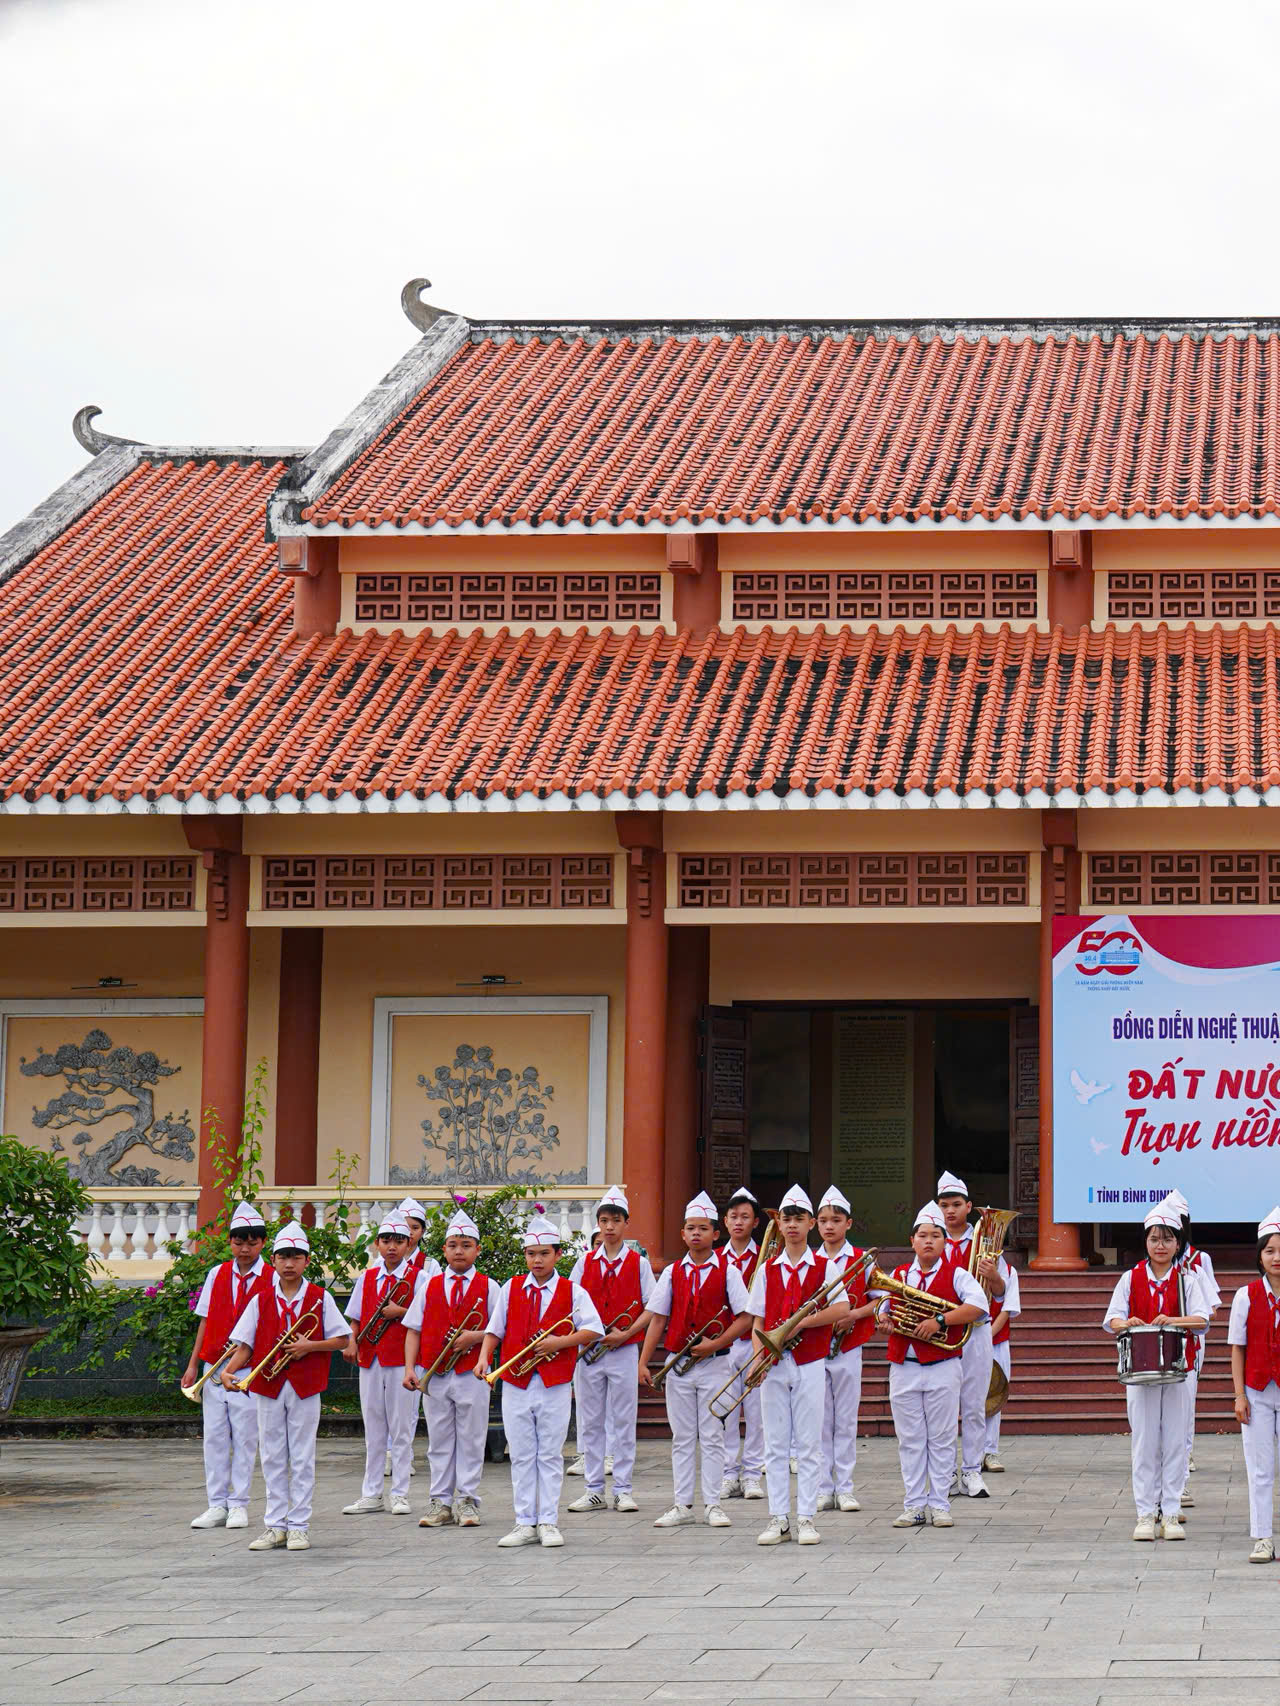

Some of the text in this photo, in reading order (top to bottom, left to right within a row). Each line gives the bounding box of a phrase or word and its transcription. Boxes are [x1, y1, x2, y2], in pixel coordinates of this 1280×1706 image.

[1113, 1010, 1154, 1040] ĐỒNG
[1158, 1009, 1194, 1040] DIỄN
[1198, 1013, 1238, 1044] NGHỆ
[1128, 1056, 1206, 1100] ĐẤT
[1120, 1108, 1202, 1166] Trọn
[1097, 1186, 1174, 1205] TỈNH BÌNH ĐỊN
